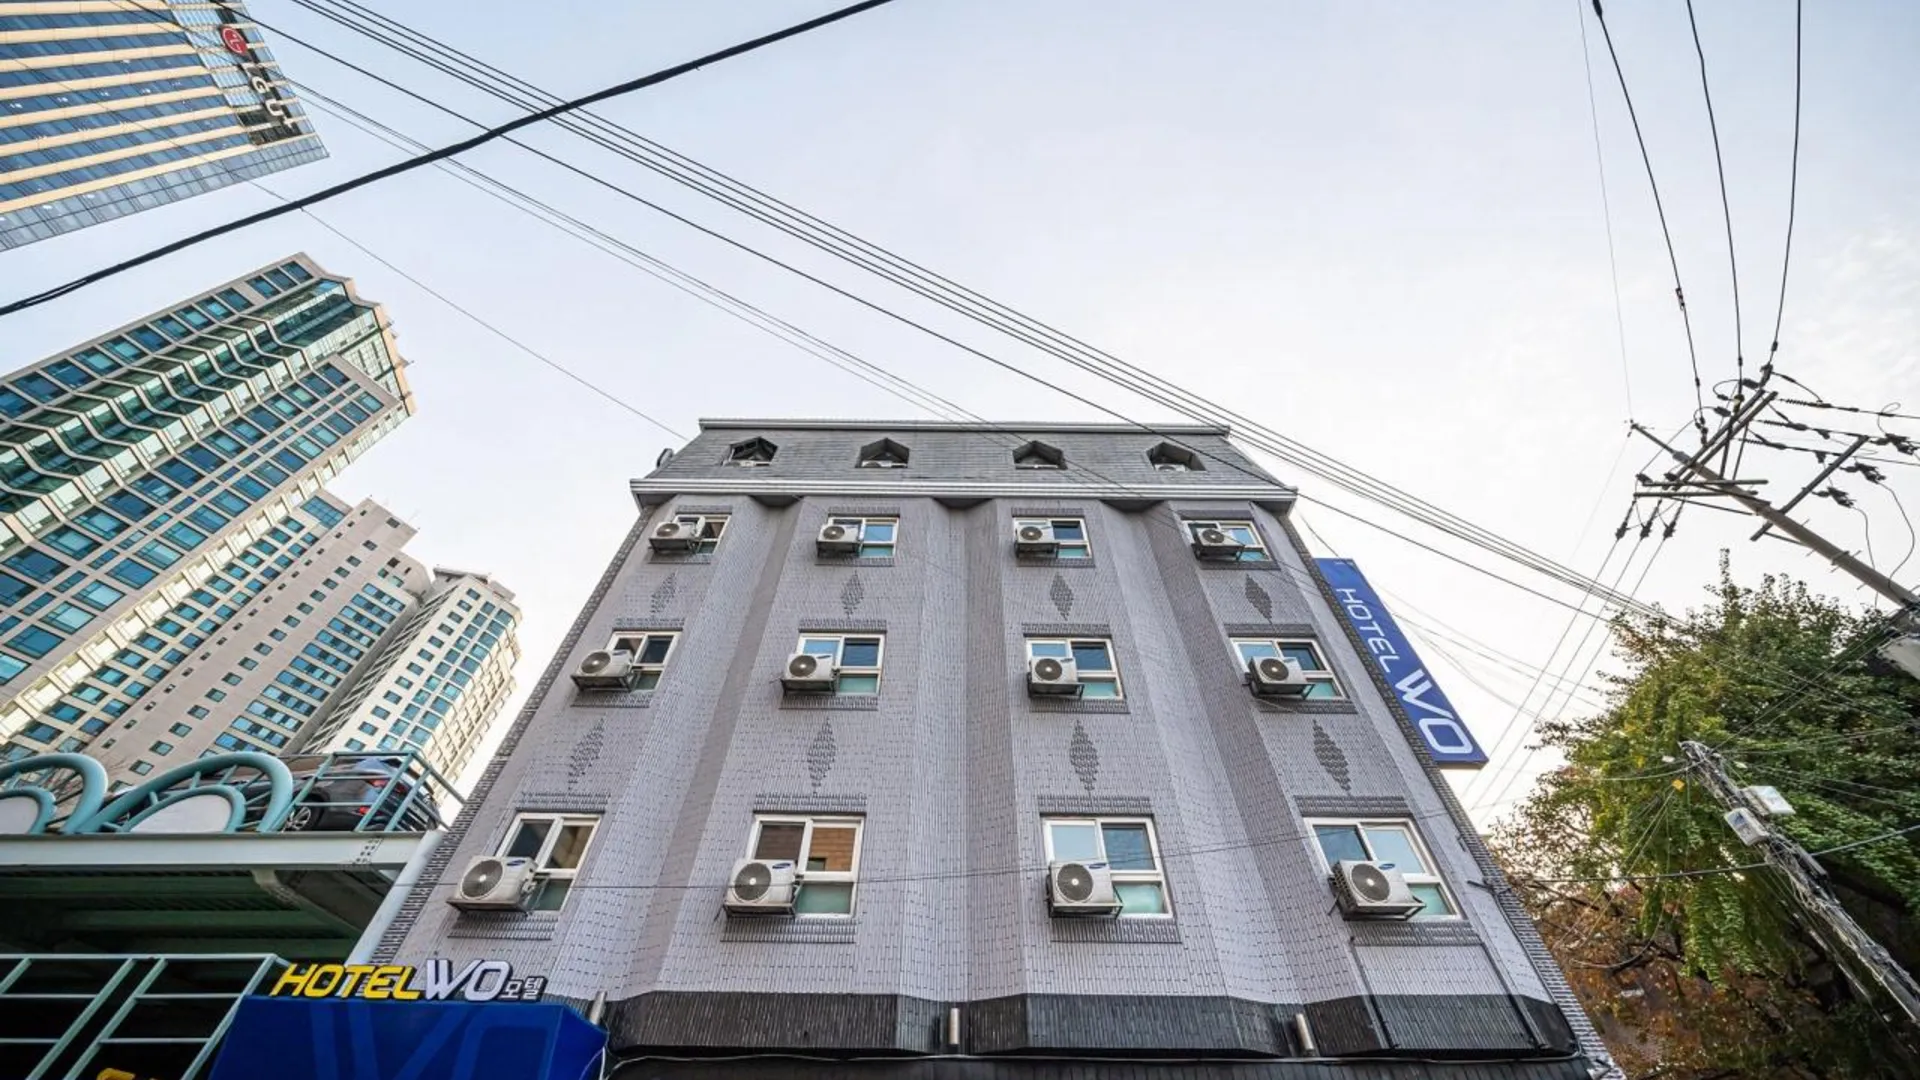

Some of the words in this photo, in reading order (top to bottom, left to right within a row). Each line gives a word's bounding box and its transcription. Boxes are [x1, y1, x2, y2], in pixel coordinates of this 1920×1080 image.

[1336, 588, 1400, 673] HOTEL
[1395, 668, 1473, 754] WO
[270, 963, 421, 999] HOTEL
[425, 959, 511, 1001] WO
[500, 977, 544, 1000] 모텔
